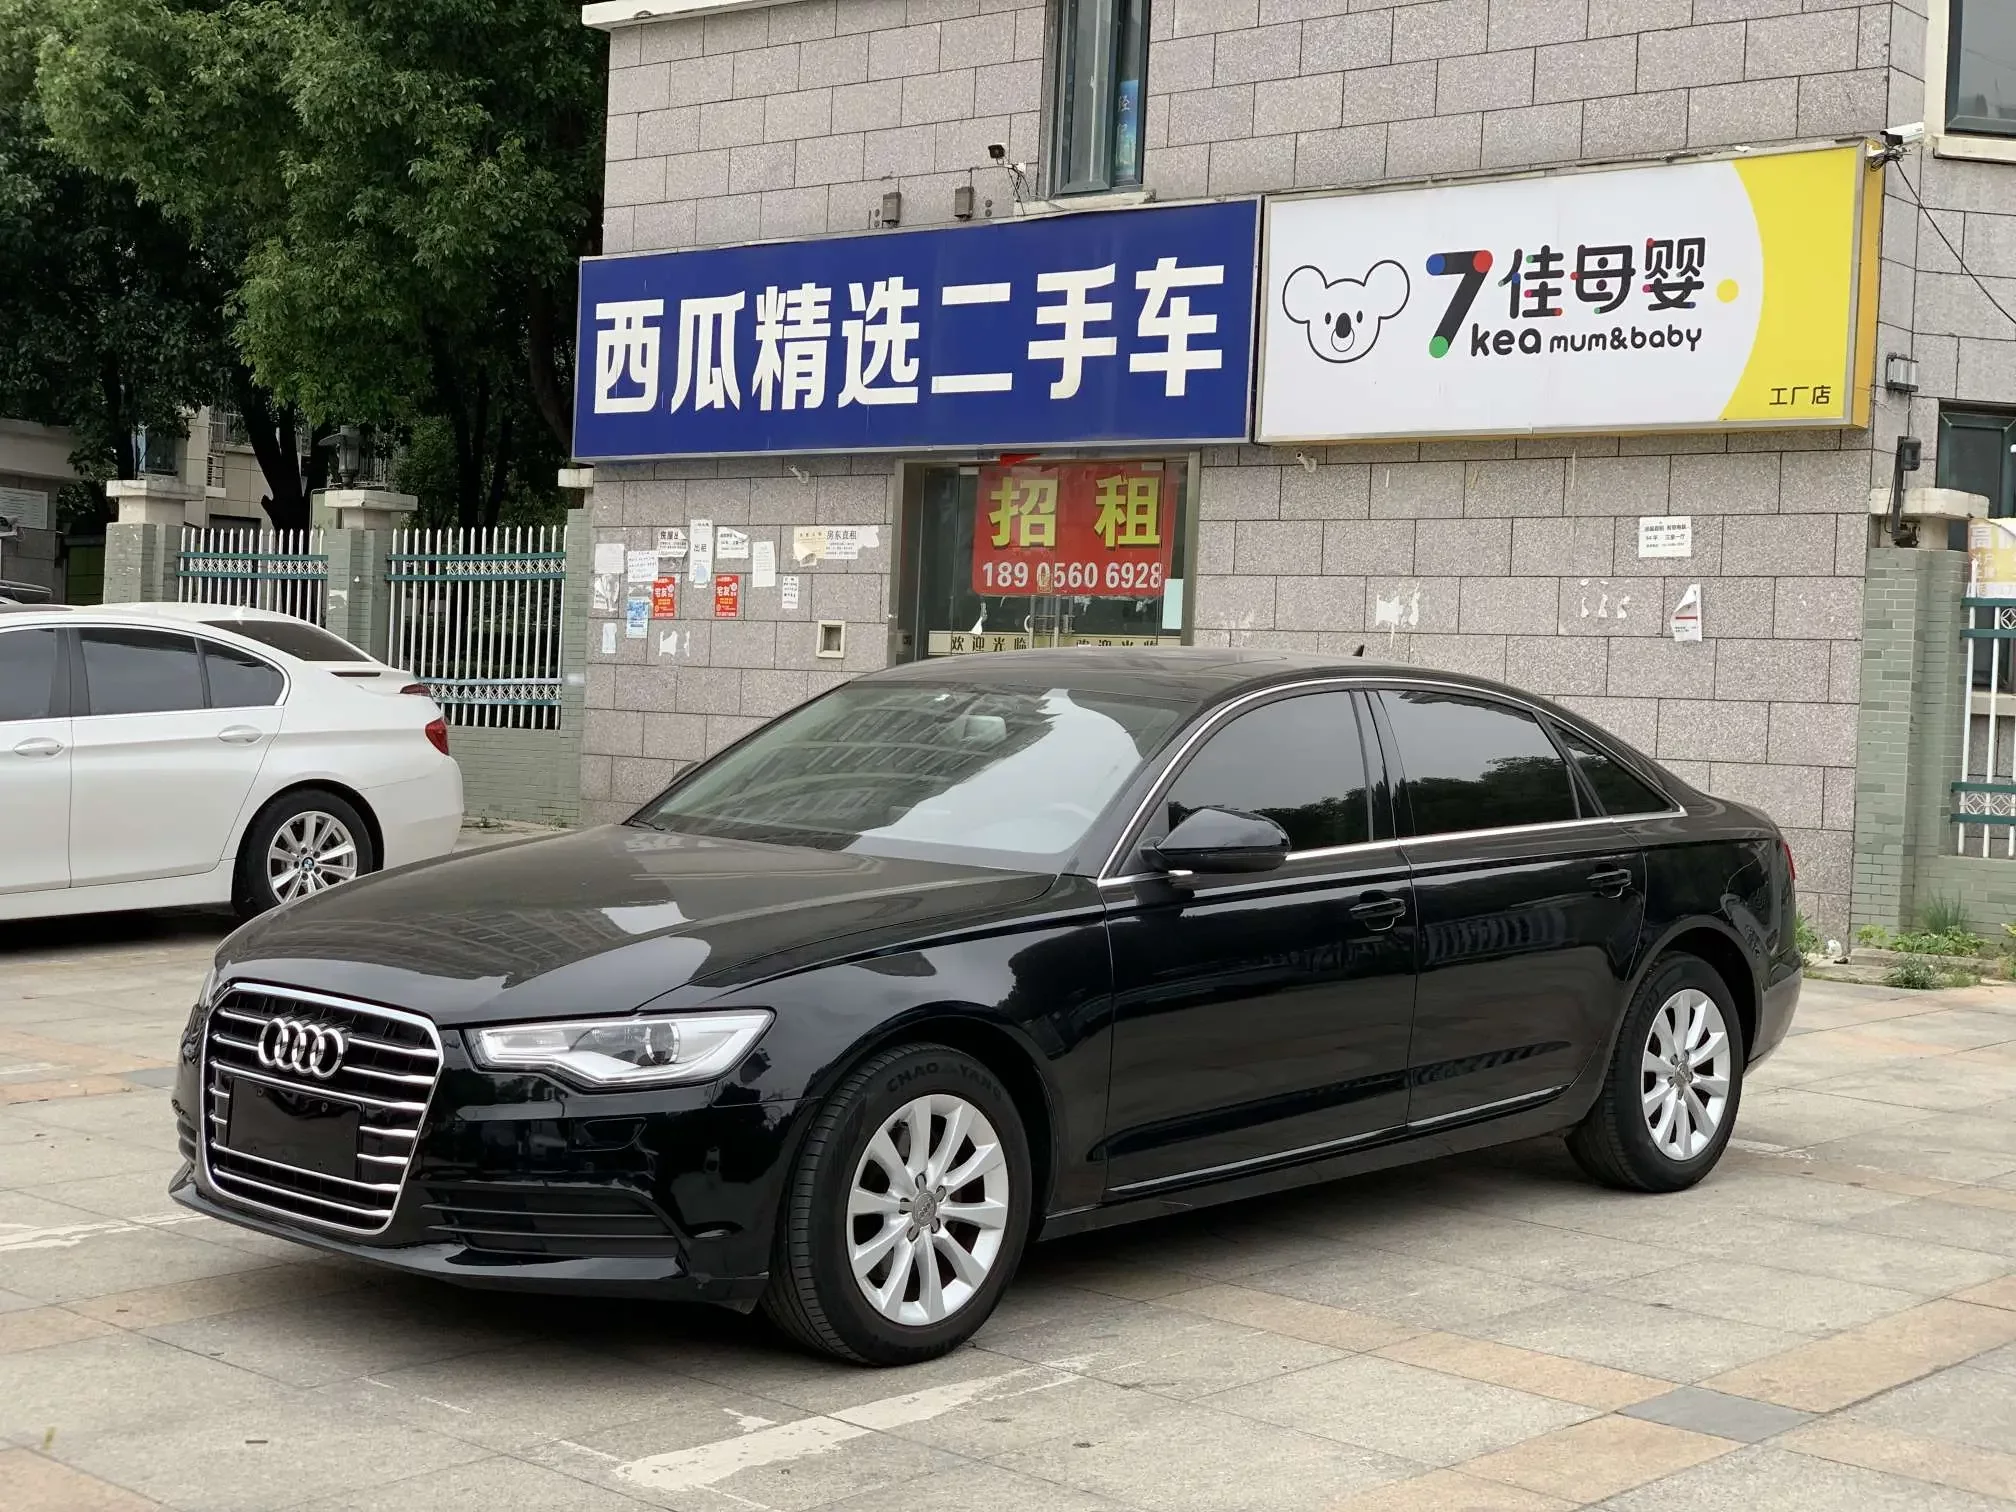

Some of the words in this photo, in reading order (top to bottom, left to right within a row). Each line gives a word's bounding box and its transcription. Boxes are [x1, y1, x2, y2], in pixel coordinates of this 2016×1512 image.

[593, 256, 1226, 415] 西瓜精选二手车
[1550, 324, 1702, 352] mum&baby
[1769, 385, 1831, 405] 工厂店
[988, 475, 1161, 548] 招租
[982, 562, 1029, 588] 189
[1036, 562, 1099, 589] 0560
[1105, 562, 1162, 589] 6928
